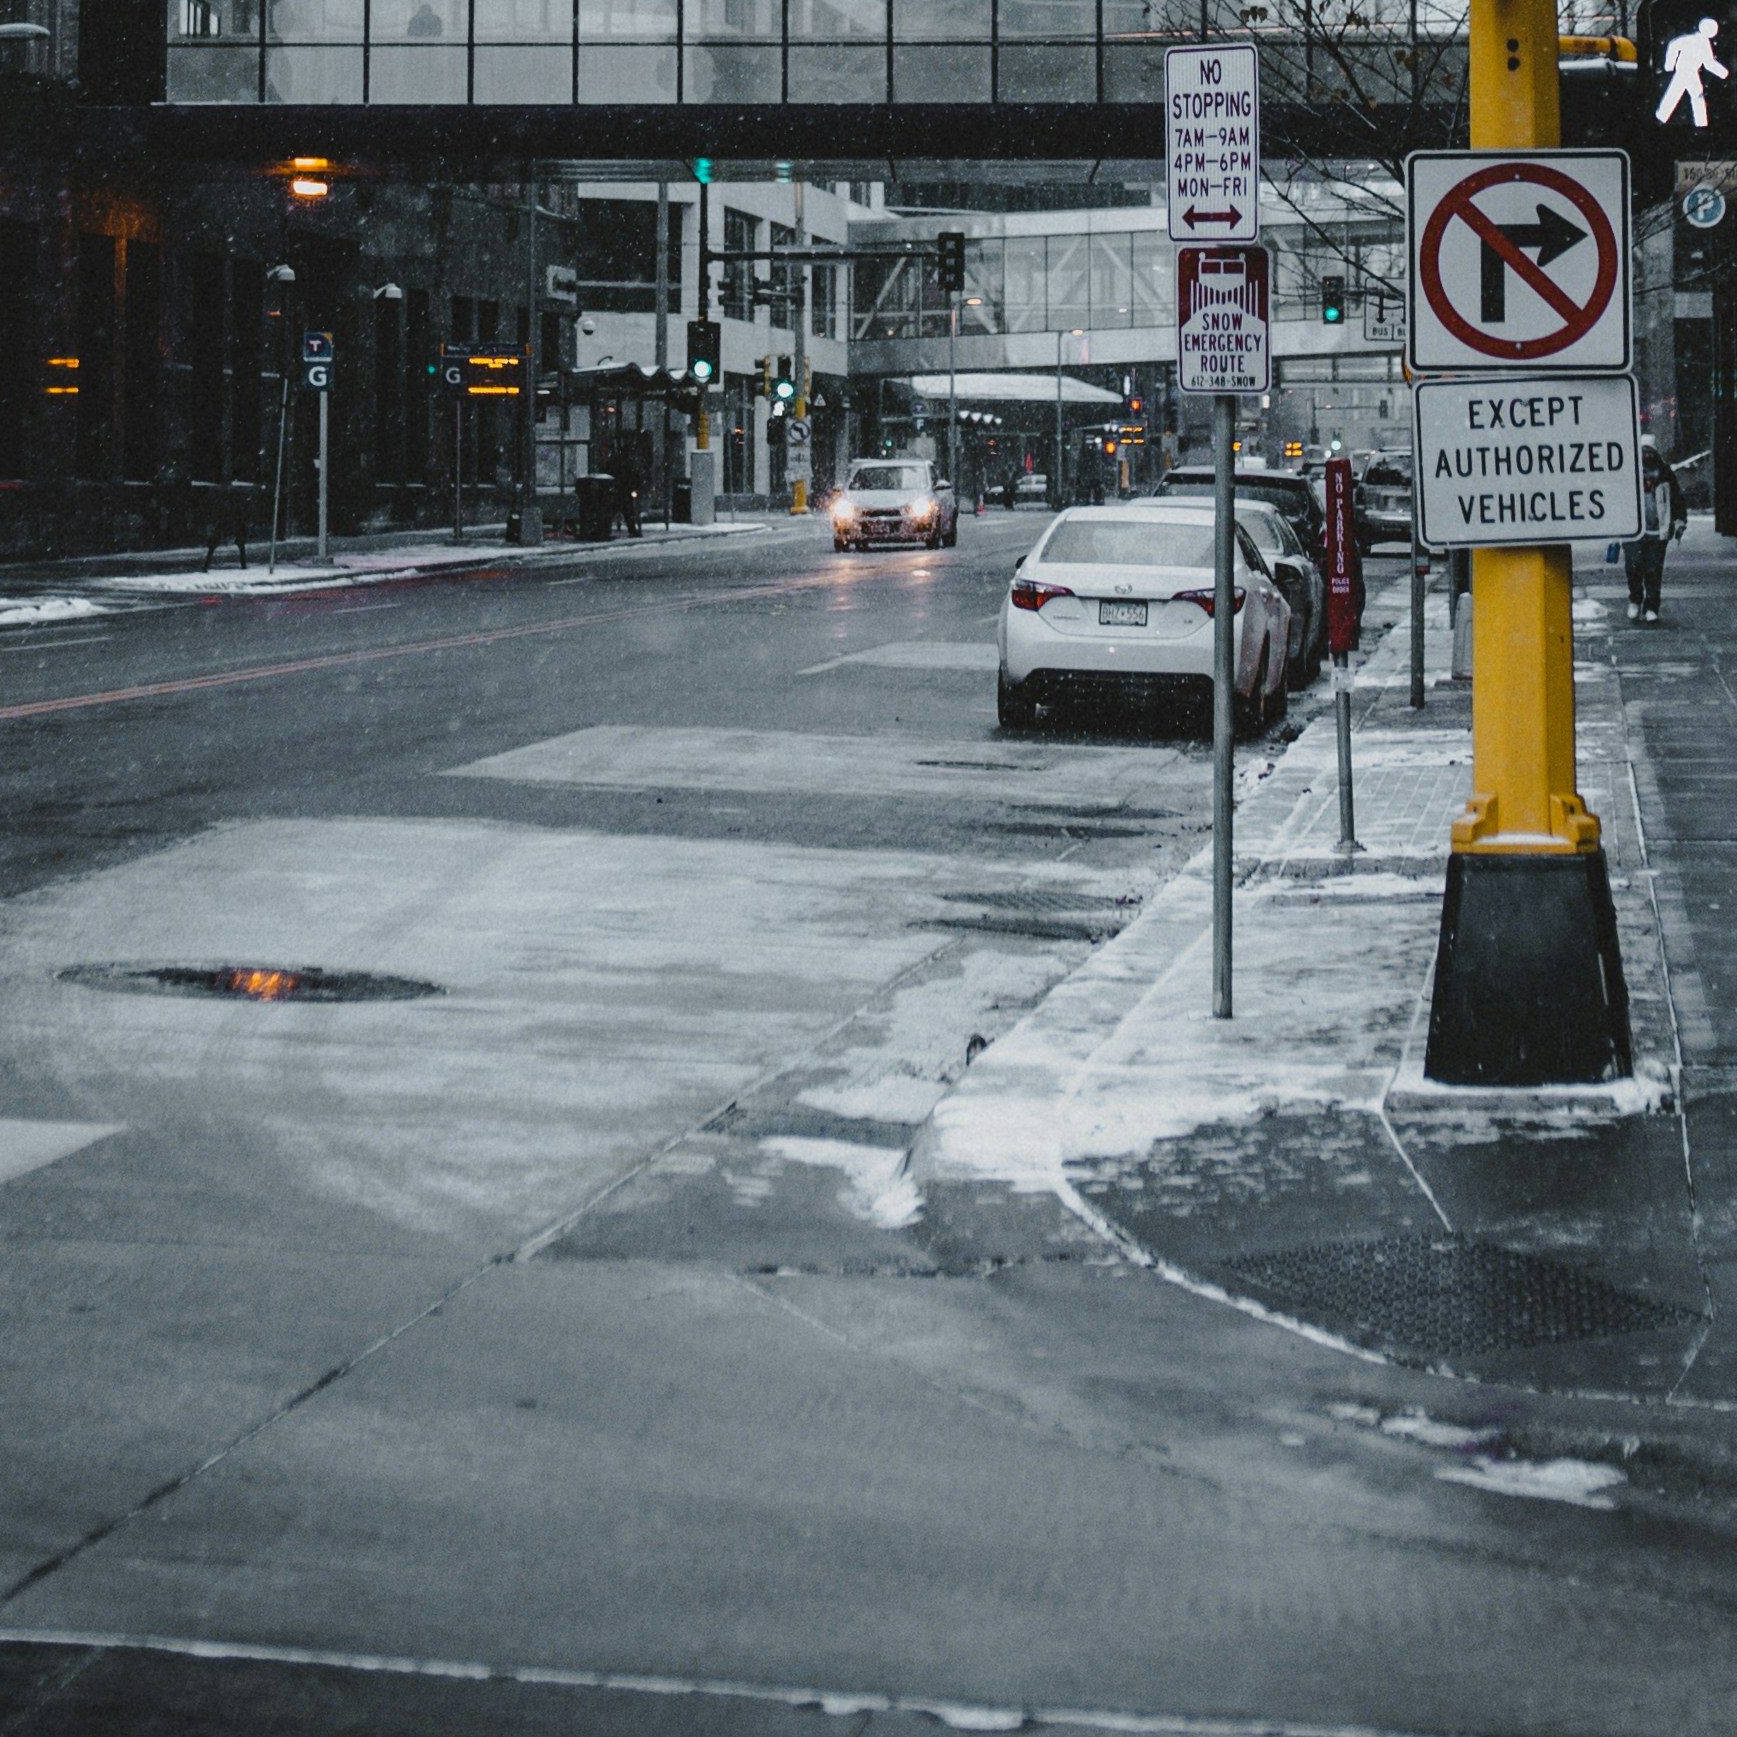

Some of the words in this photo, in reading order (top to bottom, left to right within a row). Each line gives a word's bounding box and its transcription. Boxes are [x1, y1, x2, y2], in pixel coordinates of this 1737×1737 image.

[1200, 59, 1222, 85] NO
[1172, 91, 1252, 120] STOPPING
[1175, 127, 1250, 148] 7AM-9AM
[1174, 151, 1251, 173] 4PM-6PM
[1177, 176, 1247, 198] MON-FRI
[1202, 312, 1243, 332] SNOW
[1373, 326, 1389, 337] BUS
[309, 339, 322, 352] T
[1184, 333, 1262, 353] EMERGENCY
[1200, 354, 1245, 374] ROUTE
[308, 365, 327, 387] G
[445, 367, 461, 384] G
[1191, 376, 1256, 388] 612-348-SNOW
[1468, 395, 1583, 430] EXCEPT
[1435, 441, 1624, 479] AUTHORIZED
[1335, 472, 1344, 494] NO
[1457, 489, 1605, 525] VEHICLES
[1336, 498, 1345, 574] PARKING
